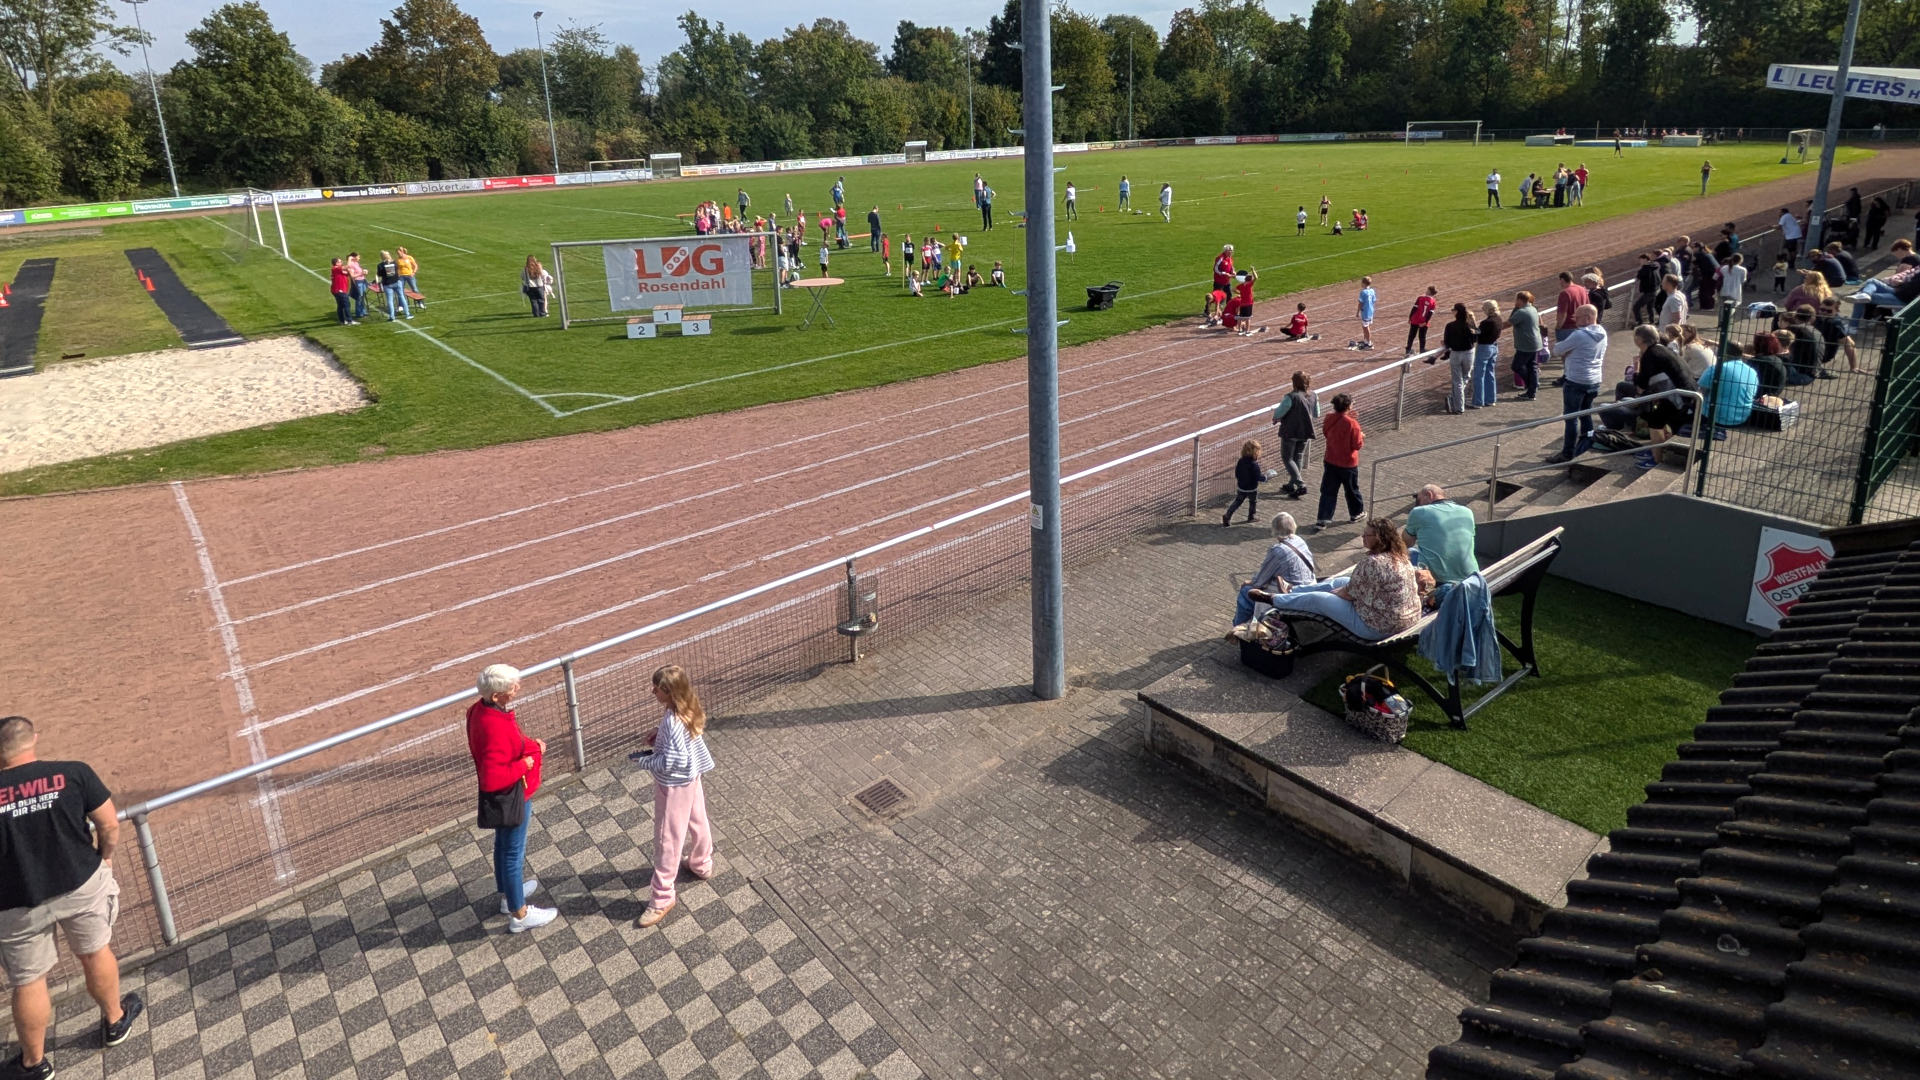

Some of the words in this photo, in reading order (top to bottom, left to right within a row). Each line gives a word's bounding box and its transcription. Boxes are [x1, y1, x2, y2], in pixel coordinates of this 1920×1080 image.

[638, 278, 726, 293] Rosendahl
[663, 311, 670, 322] 1
[637, 325, 646, 336] 2
[692, 322, 700, 333] 3
[1772, 580, 1815, 602] OSTE
[0, 802, 16, 814] WAS
[18, 796, 37, 808] DEIN
[39, 791, 59, 802] HERZ
[12, 807, 28, 818] DIR
[30, 800, 54, 812] SAGT
